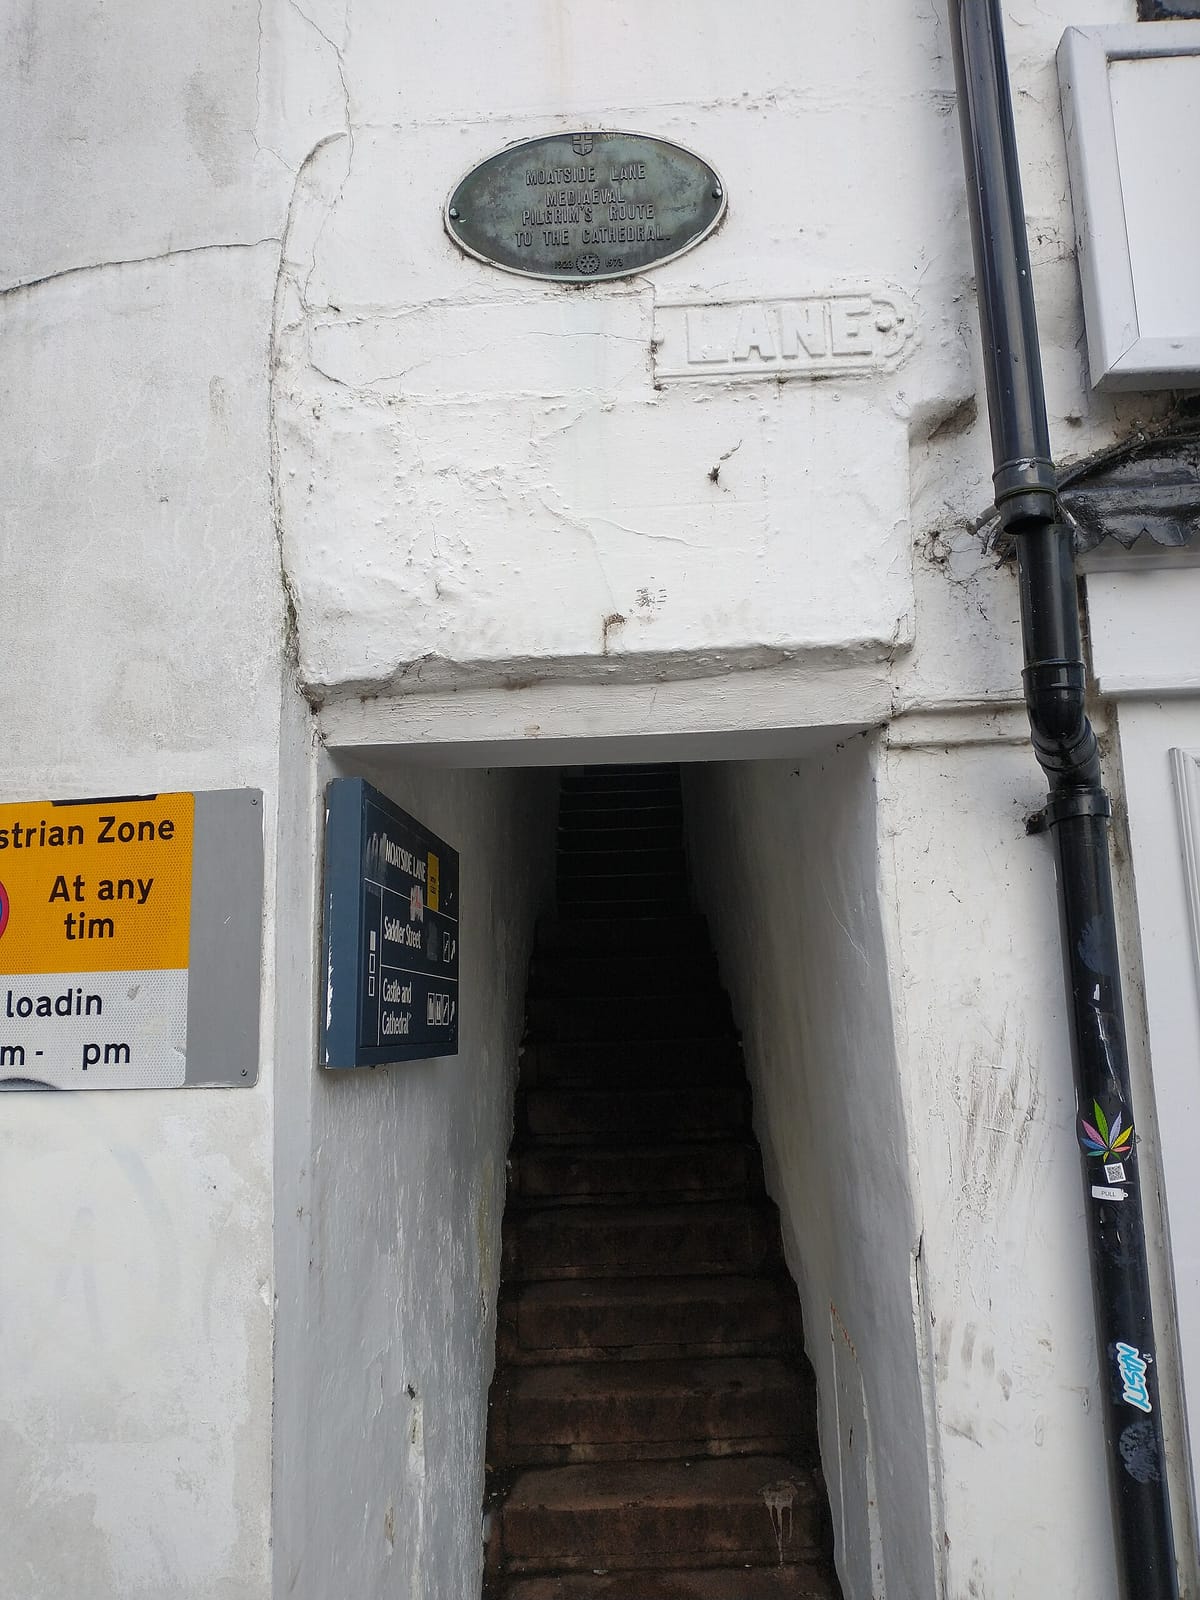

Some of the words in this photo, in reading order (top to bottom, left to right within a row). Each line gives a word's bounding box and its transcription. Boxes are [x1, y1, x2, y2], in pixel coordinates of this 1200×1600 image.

[525, 166, 596, 186] MOATSIDE
[610, 163, 647, 181] LANE
[545, 187, 626, 207] MEDIAEVAL
[522, 206, 593, 226] PILGRIM'S
[608, 204, 655, 220] ROUTE
[514, 230, 532, 248] TO
[543, 229, 569, 246] THE
[684, 299, 873, 365] LANE
[97, 816, 175, 843] Zone
[385, 839, 412, 875] MOATSIDE
[412, 856, 427, 882] LANE
[48, 875, 86, 903] At
[97, 877, 154, 905] any
[64, 912, 115, 940] tim
[384, 915, 405, 944] Saddler
[405, 923, 422, 949] Street
[6, 988, 103, 1018] loadin
[382, 977, 401, 1003] Castle
[401, 981, 412, 1004] and
[82, 1041, 131, 1070] pm
[1101, 1189, 1117, 1198] PULL
[1116, 1342, 1152, 1413] NASTY
